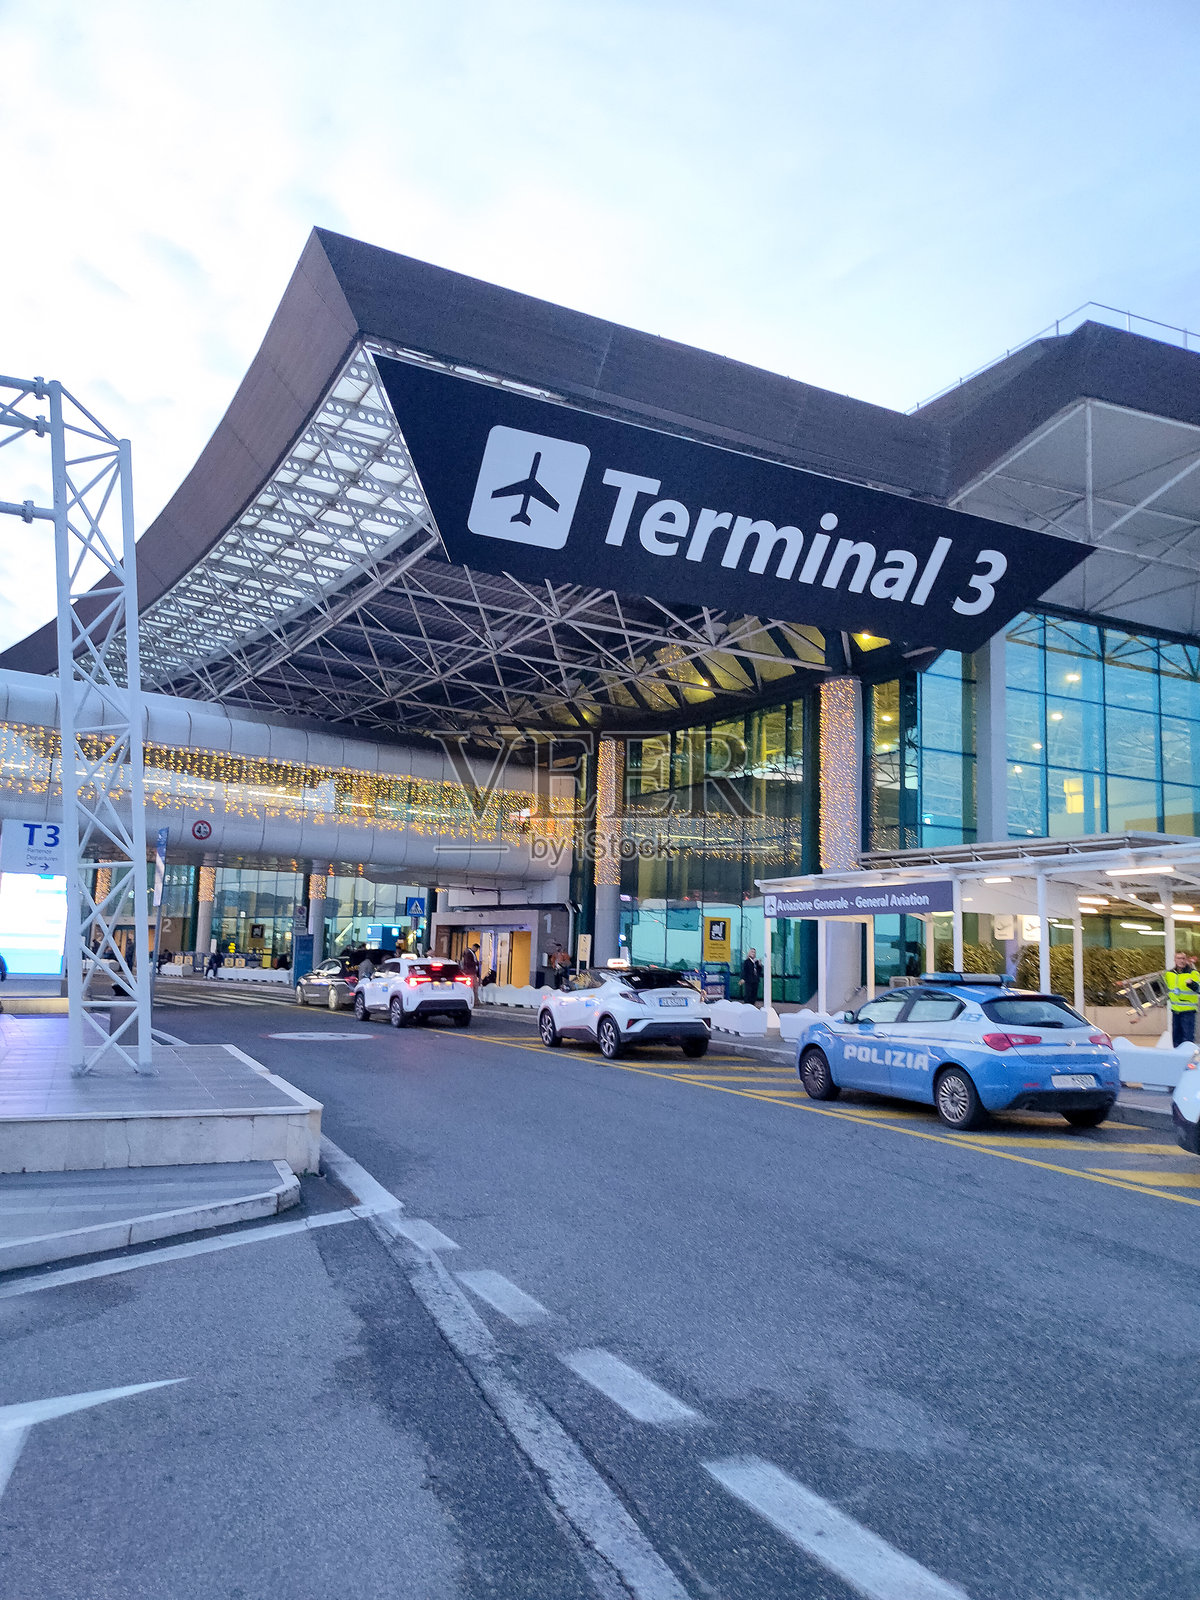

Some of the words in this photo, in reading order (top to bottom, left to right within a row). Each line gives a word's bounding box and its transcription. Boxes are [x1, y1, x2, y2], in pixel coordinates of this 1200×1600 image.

[602, 468, 952, 606] Terminal
[951, 549, 1008, 616] 3
[23, 823, 60, 847] T3
[776, 899, 813, 912] Aviazione
[813, 896, 849, 911] Generale
[855, 894, 889, 909] General
[890, 892, 930, 907] Aviation
[162, 918, 172, 933] 2
[543, 913, 552, 934] 1
[843, 1043, 930, 1072] POLIZIA
